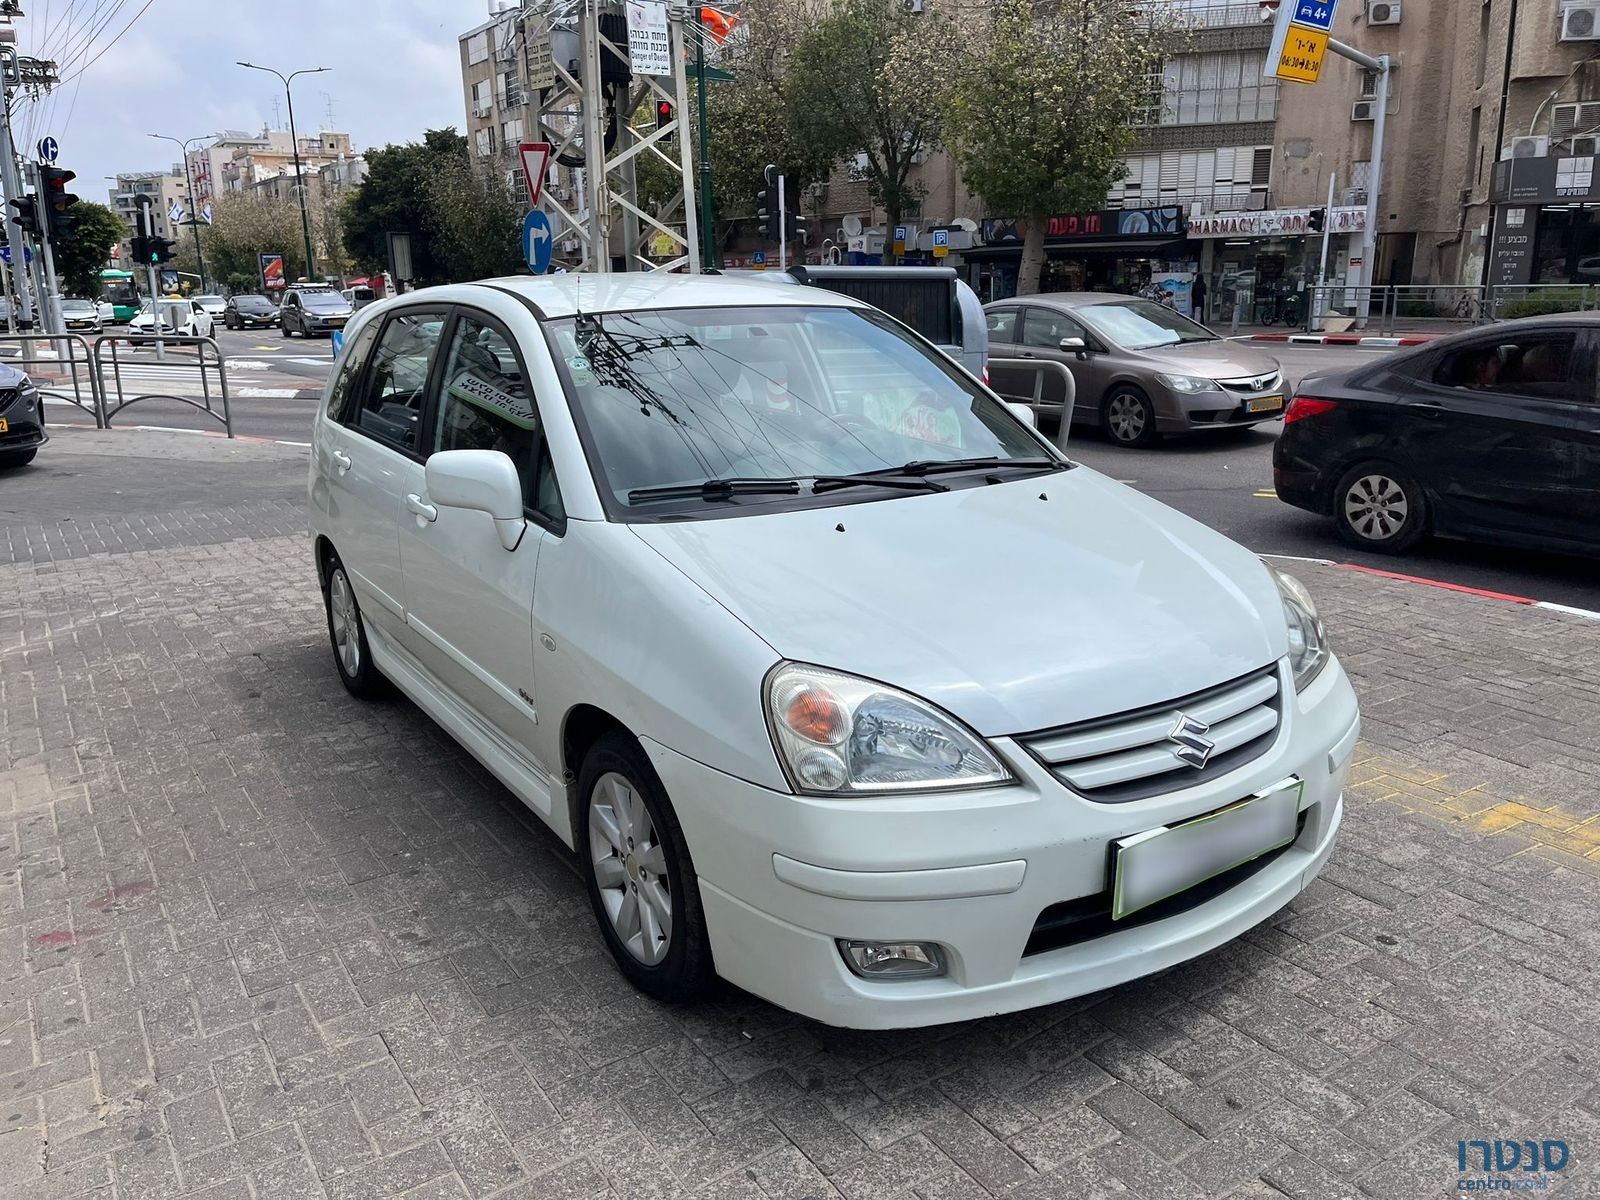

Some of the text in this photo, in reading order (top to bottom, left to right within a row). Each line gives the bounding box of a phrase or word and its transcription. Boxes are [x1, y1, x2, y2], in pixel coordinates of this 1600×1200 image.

[1314, 8, 1327, 19] 4+
[651, 31, 667, 41] מתח
[631, 50, 647, 61] Danger
[1188, 218, 1256, 235] PHARMACY
[1508, 235, 1528, 244] מבצע
